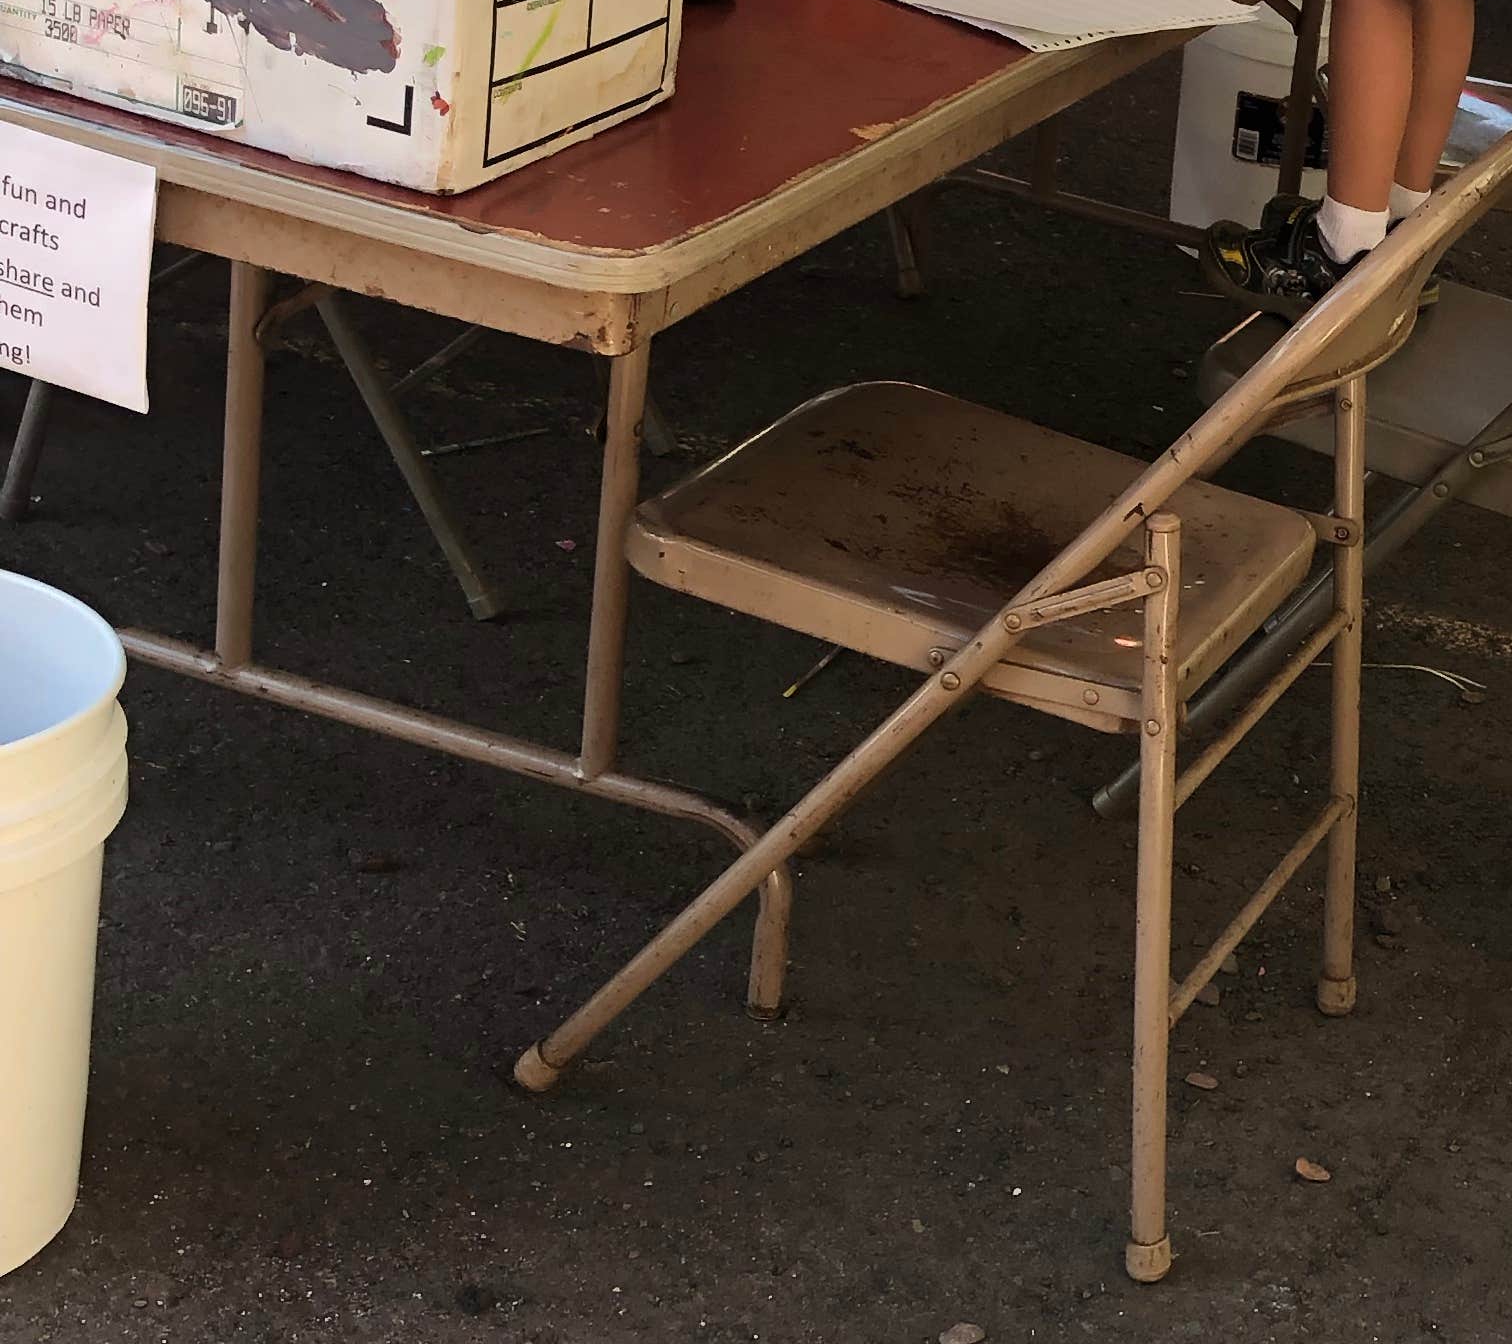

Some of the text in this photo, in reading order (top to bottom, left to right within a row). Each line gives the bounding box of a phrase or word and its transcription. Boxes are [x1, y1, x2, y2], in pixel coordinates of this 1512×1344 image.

[44, 18, 78, 44] 3500
[64, 1, 81, 24] LB
[89, 8, 130, 36] PAPER
[2, 175, 86, 220] fun and
[0, 218, 59, 251] crafts
[61, 282, 101, 307] and
